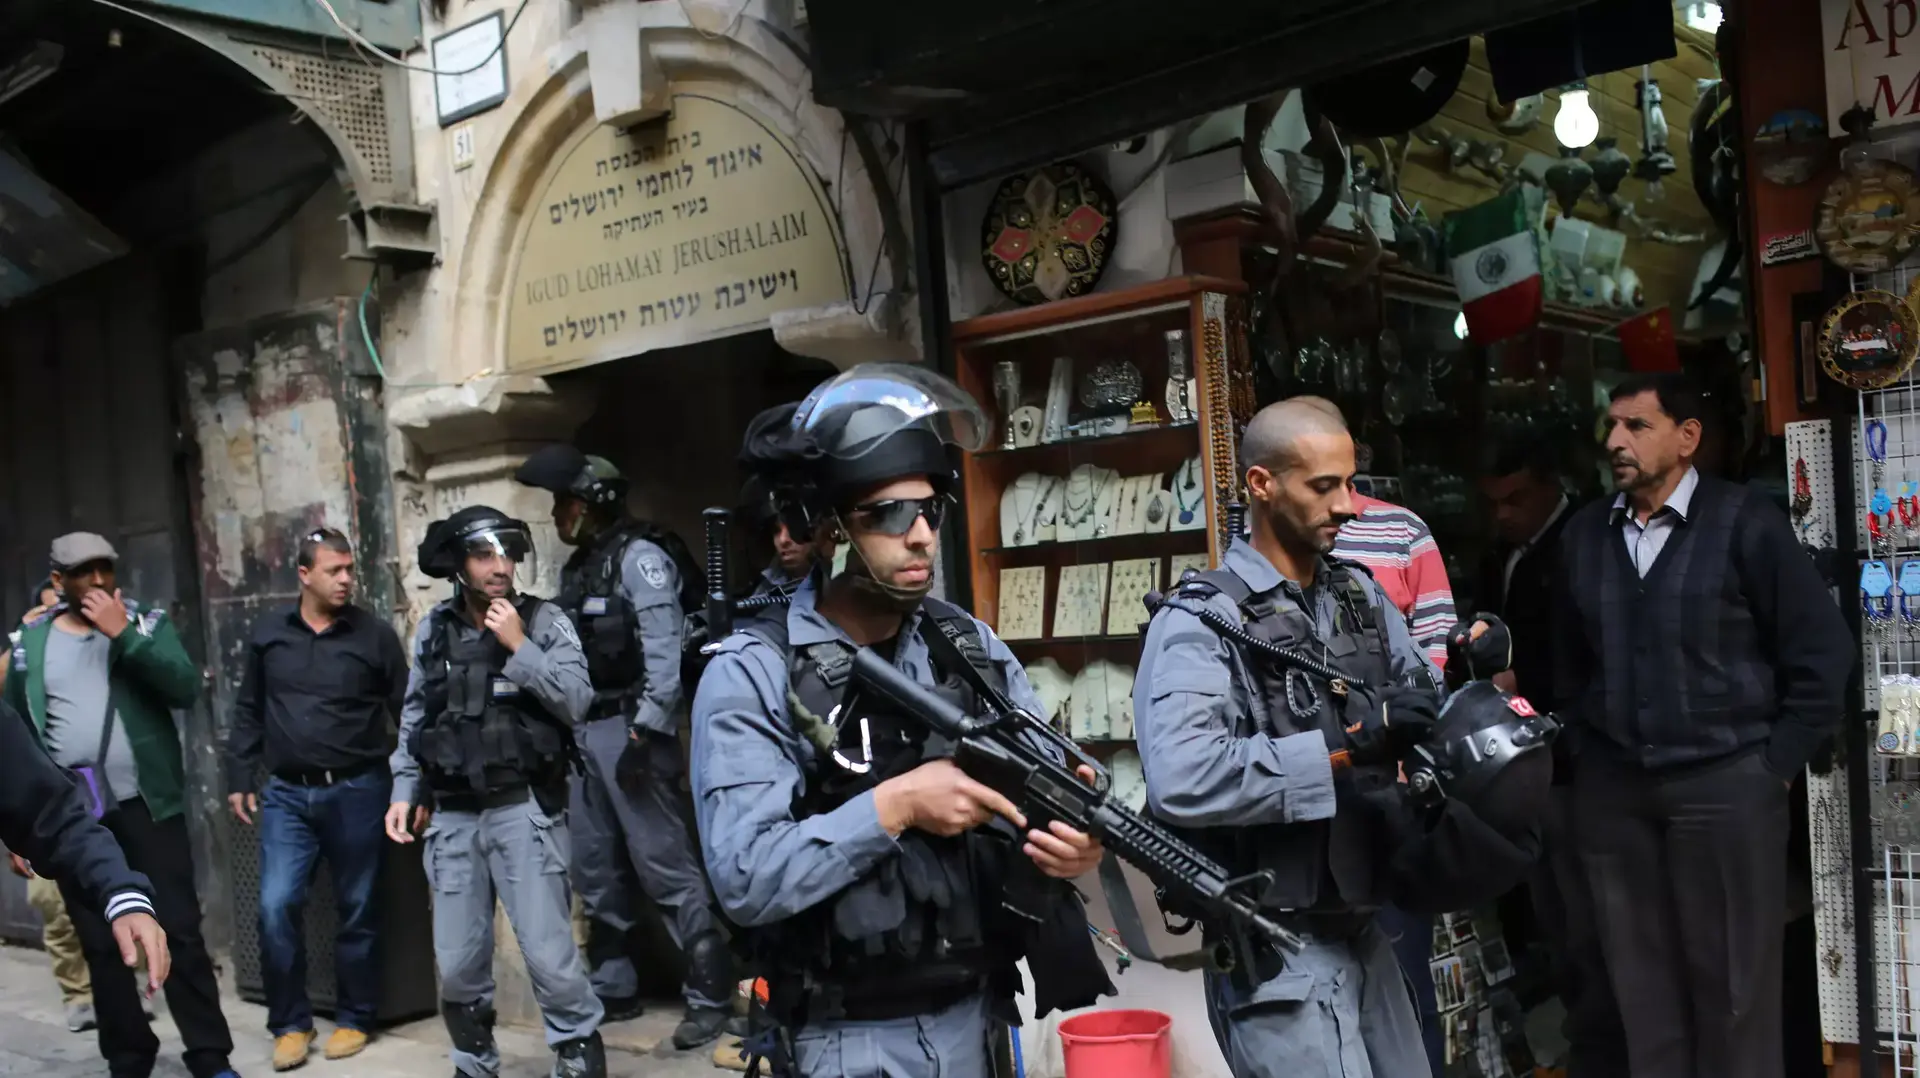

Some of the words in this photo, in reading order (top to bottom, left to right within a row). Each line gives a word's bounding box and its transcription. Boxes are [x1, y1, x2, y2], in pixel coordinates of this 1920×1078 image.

[596, 145, 656, 176] הכנסת
[666, 130, 701, 156] בית
[706, 143, 763, 179] איגוד
[636, 159, 694, 199] לוחמי
[549, 183, 624, 225] ירושלים
[672, 196, 709, 220] בעיר
[602, 208, 664, 241] העתיקה
[526, 273, 570, 306] IGUD
[576, 248, 664, 294] LOHAMAY
[672, 210, 809, 276] JERUSHALAIM
[715, 268, 799, 311] וישיבת
[639, 291, 701, 327] עטרת
[543, 309, 627, 348] ירושלים
